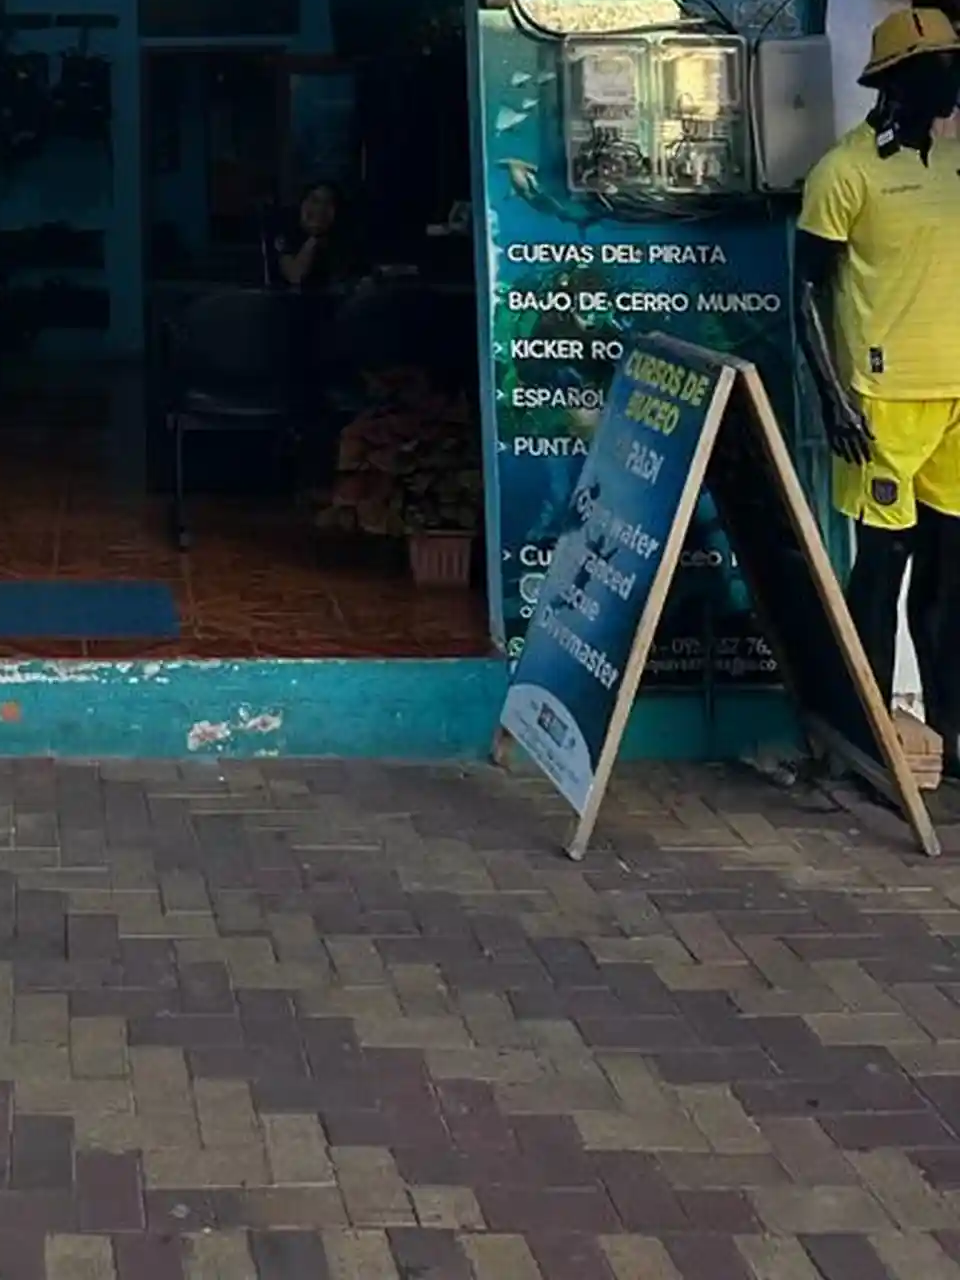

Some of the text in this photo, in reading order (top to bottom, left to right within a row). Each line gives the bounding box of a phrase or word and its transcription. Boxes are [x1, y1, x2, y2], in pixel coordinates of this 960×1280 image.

[507, 244, 727, 264] CUEVAS DEL PIRATA
[508, 292, 781, 312] BAJO DE CERRO MUNDO
[511, 340, 625, 359] KICKER RO
[679, 371, 710, 406] DE
[514, 437, 589, 457] PUNTA
